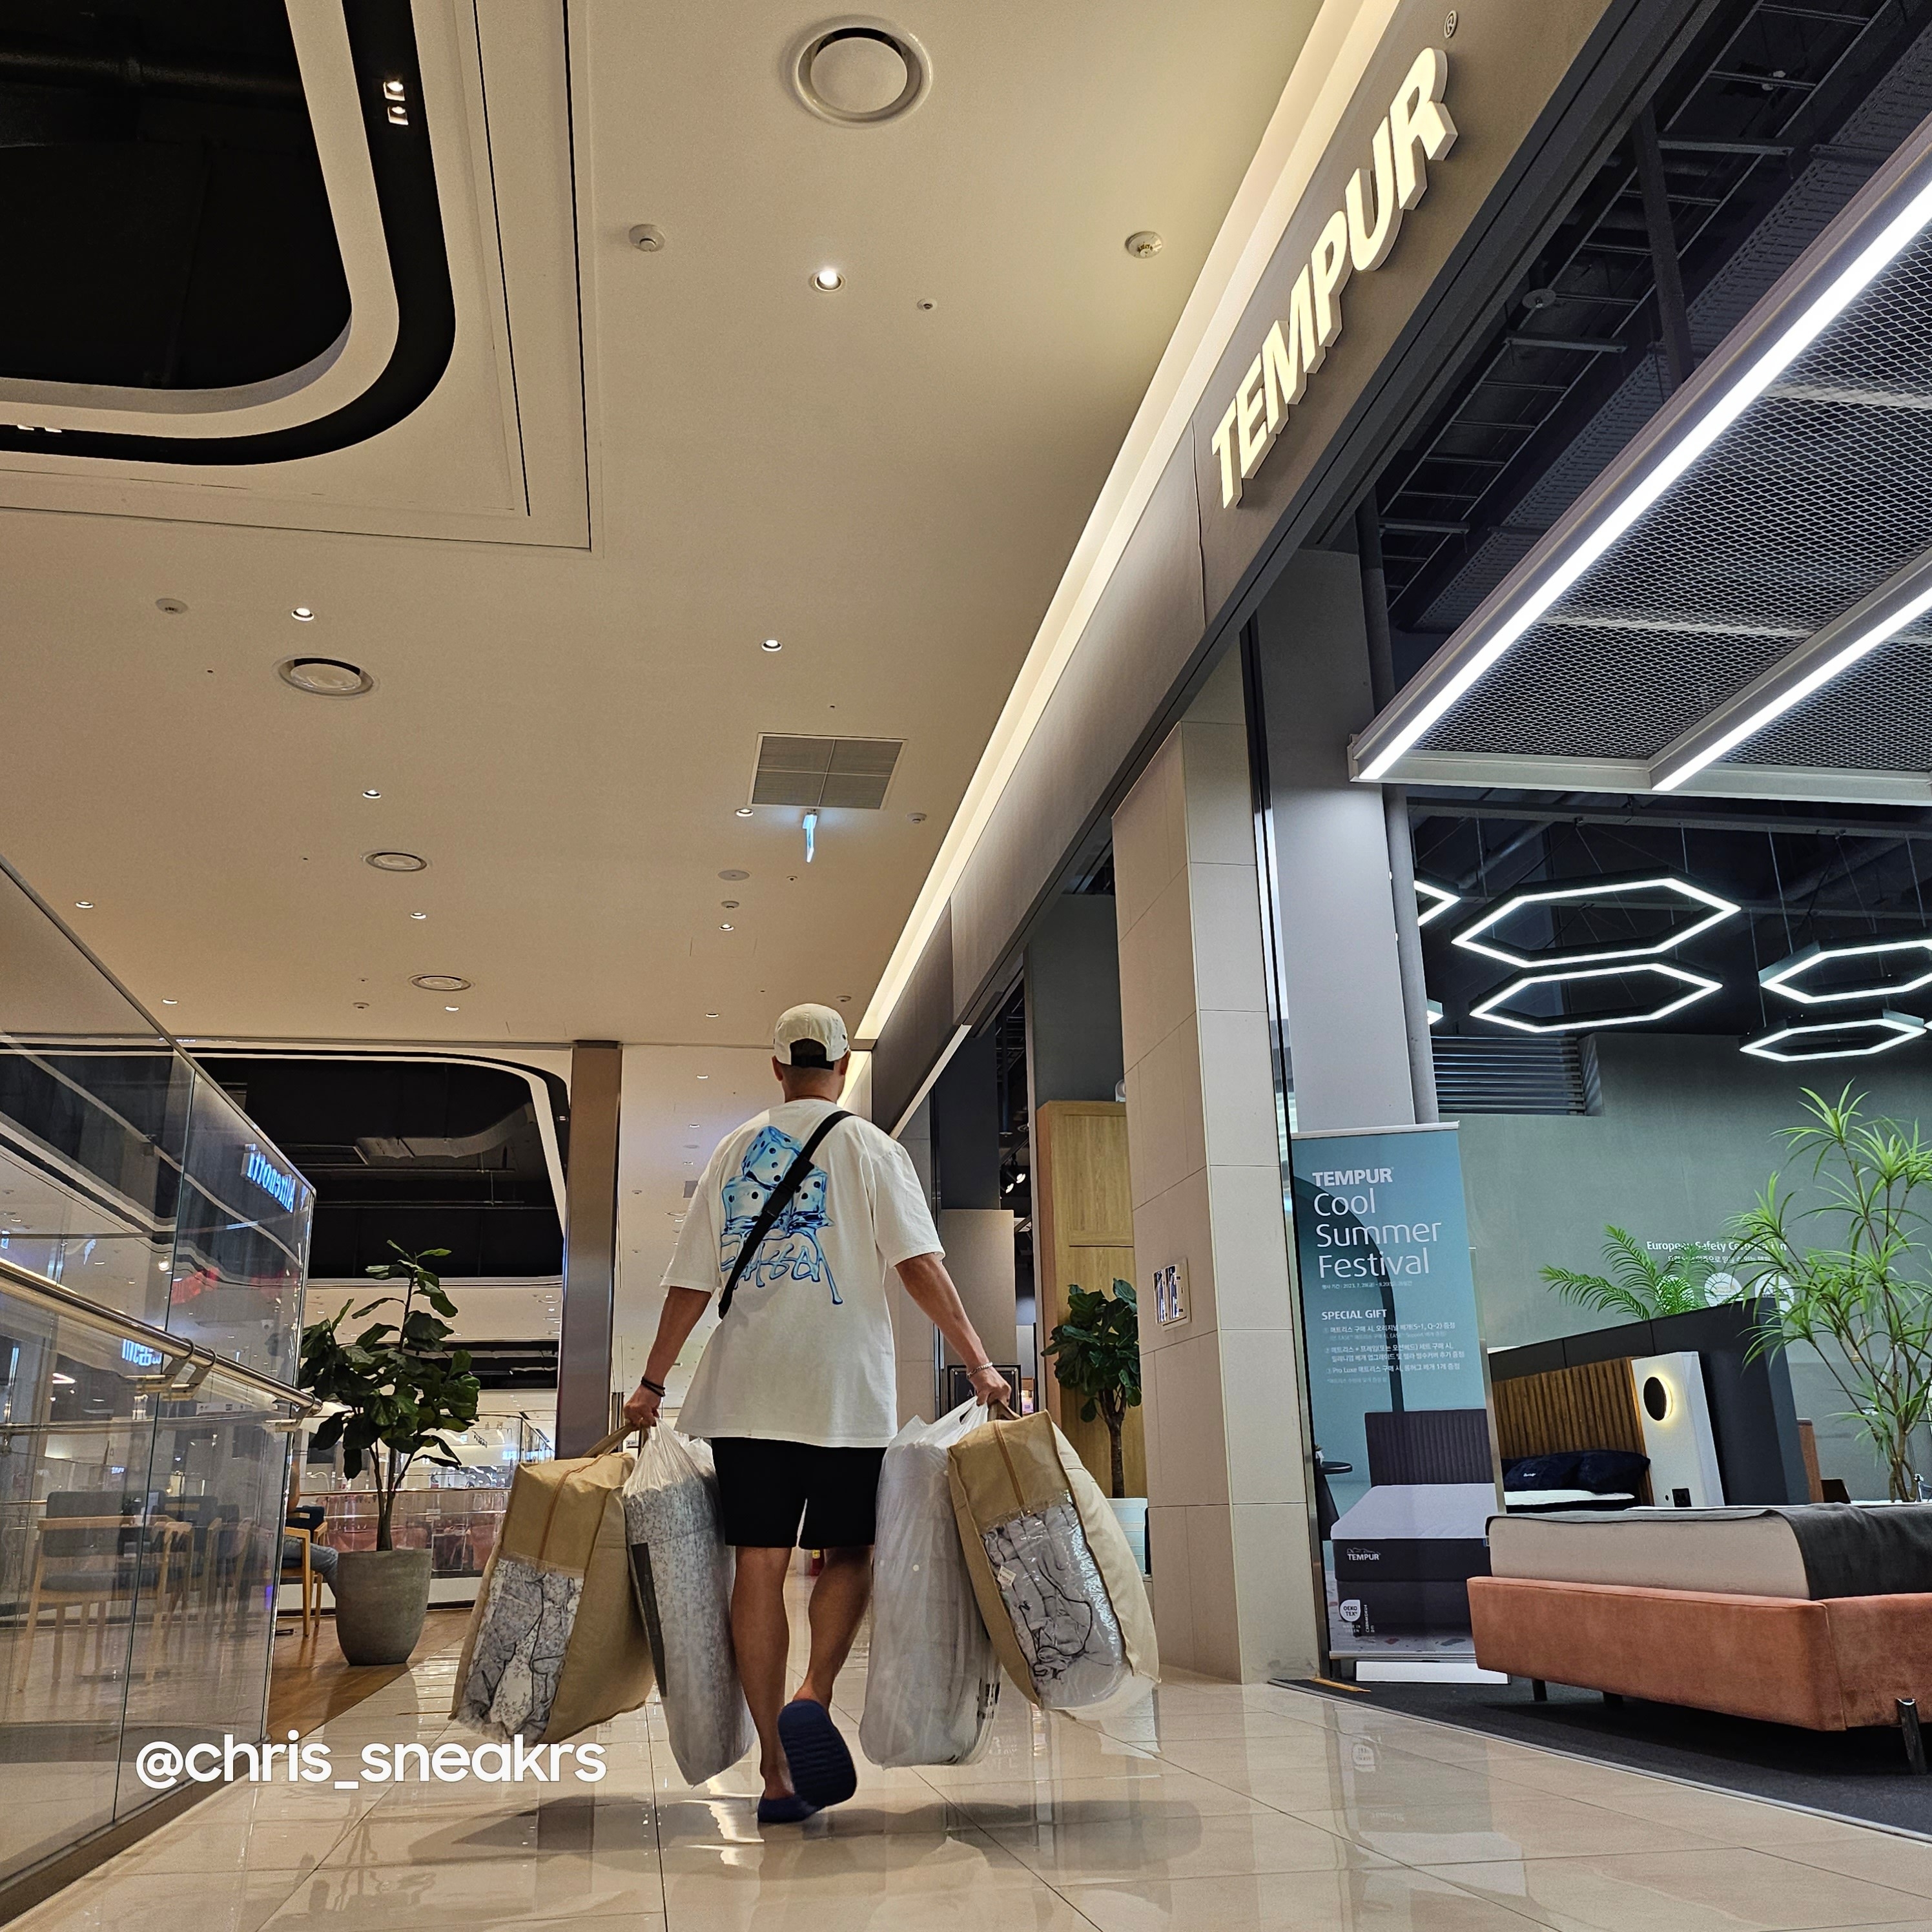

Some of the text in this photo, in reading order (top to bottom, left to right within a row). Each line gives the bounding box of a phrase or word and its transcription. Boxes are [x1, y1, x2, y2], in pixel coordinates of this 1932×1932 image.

[1211, 47, 1458, 509] TEMPUR
[1312, 1167, 1393, 1187] TEMPUR
[1313, 1187, 1375, 1217] Cool
[1316, 1222, 1441, 1248] Summer
[1319, 1247, 1429, 1279] Festival
[1321, 1309, 1387, 1321] SPECIAL GIFT
